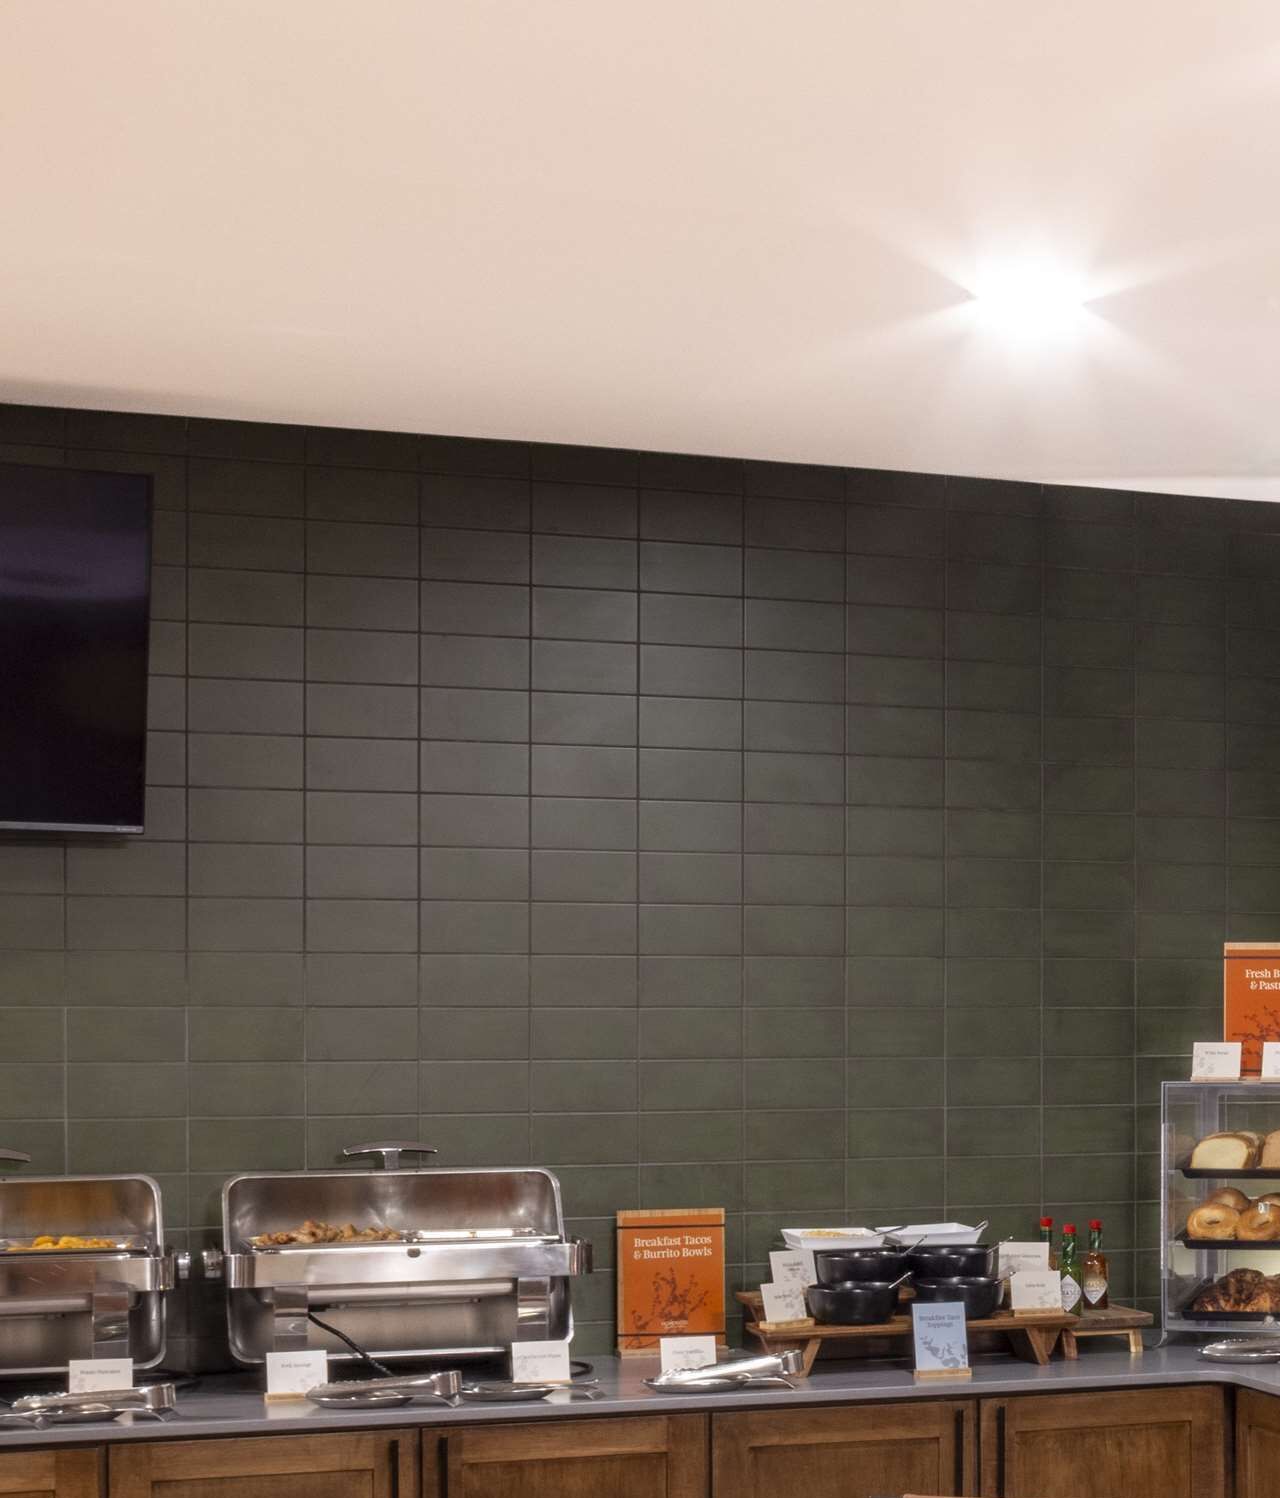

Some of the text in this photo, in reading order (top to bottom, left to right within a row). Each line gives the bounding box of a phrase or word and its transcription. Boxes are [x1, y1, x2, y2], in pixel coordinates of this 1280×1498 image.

[1245, 969, 1271, 979] Fresh
[1250, 982, 1258, 990] &
[634, 1235, 712, 1247] Breakfast Tacos
[633, 1246, 712, 1260] & Burrito Bowls
